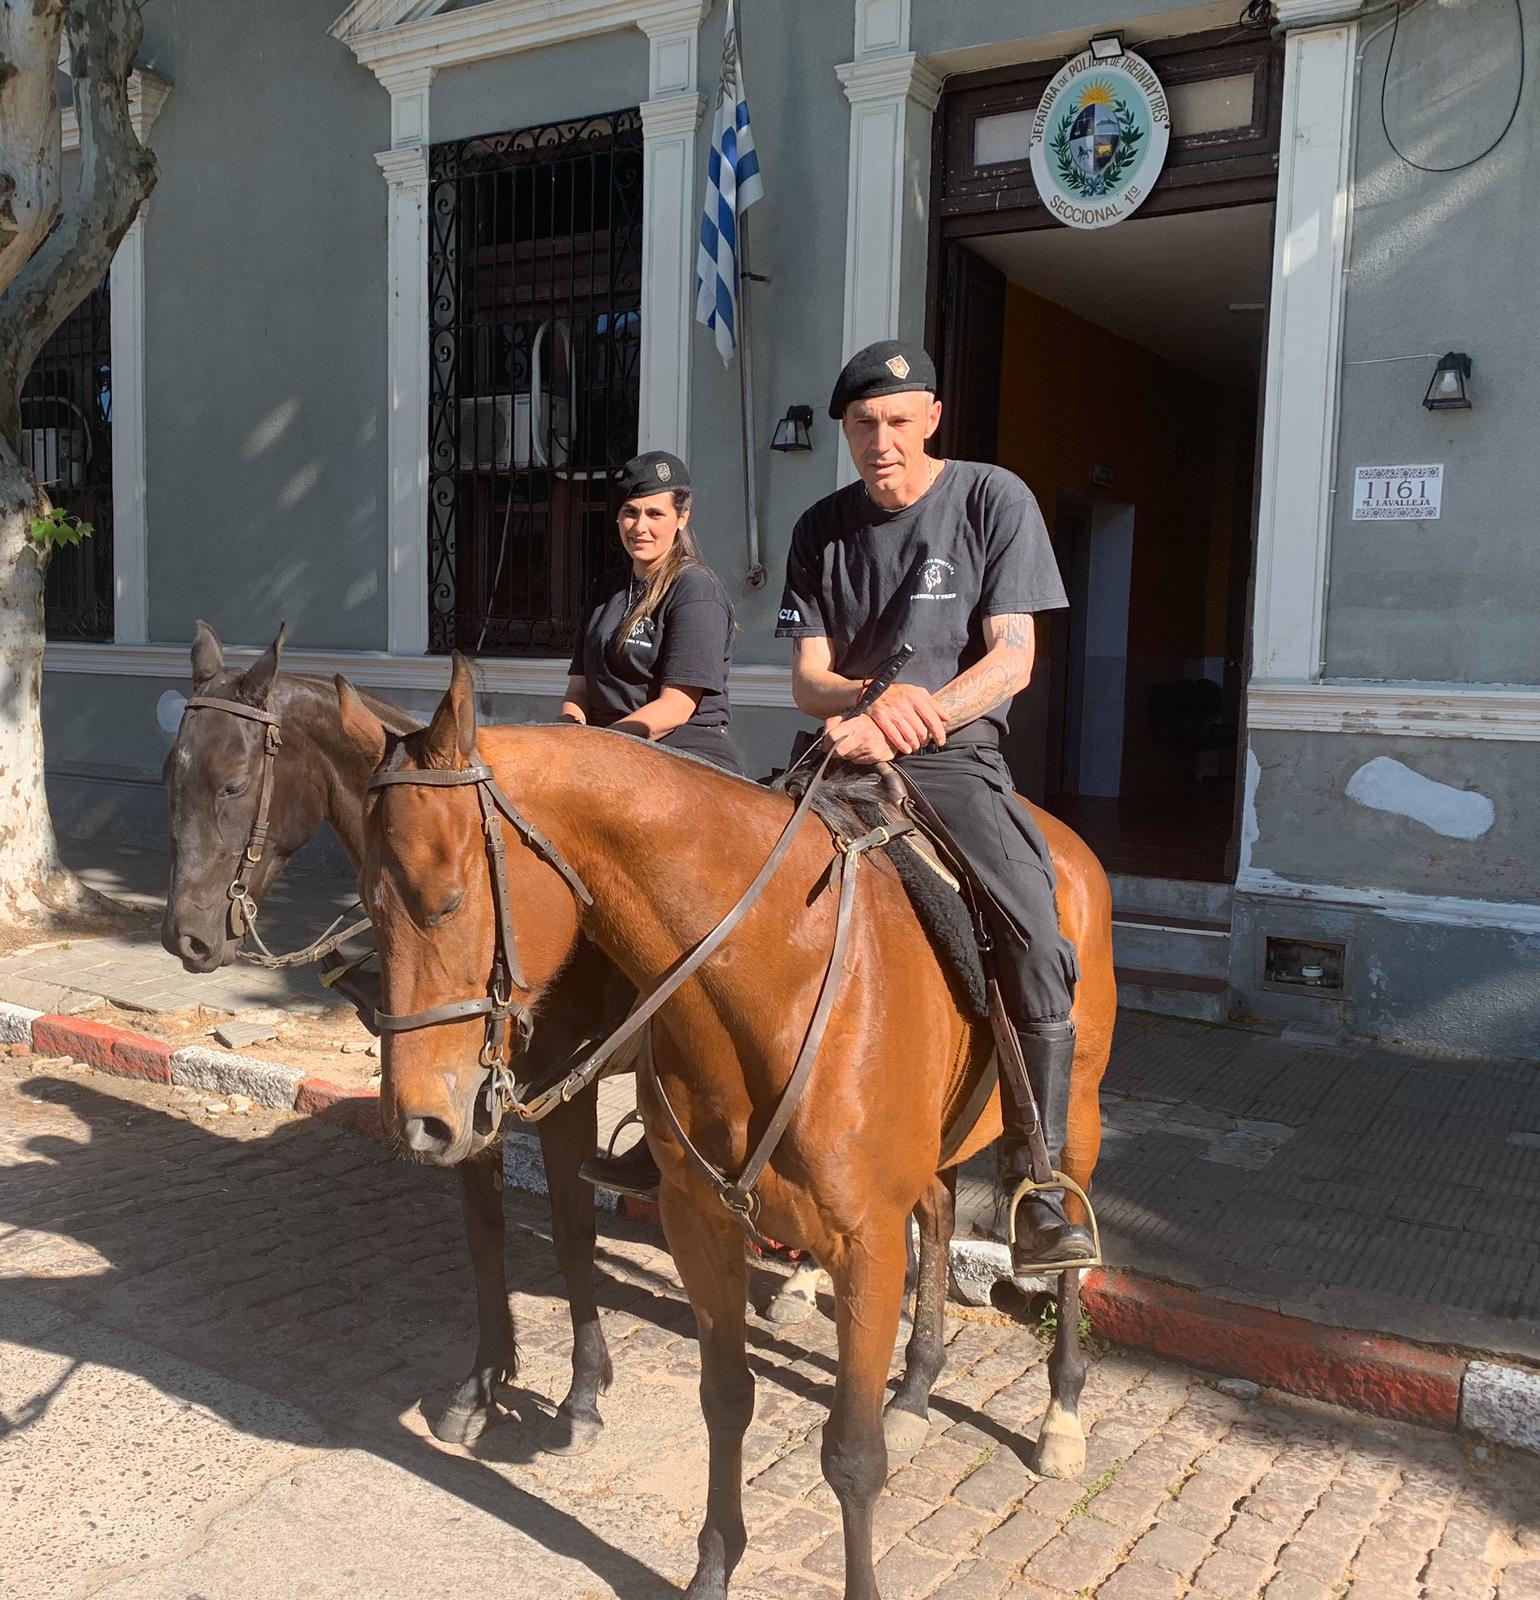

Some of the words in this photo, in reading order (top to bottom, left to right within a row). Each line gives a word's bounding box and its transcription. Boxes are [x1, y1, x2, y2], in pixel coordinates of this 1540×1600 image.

[1032, 86, 1060, 142] JEFATURA
[1058, 73, 1069, 88] DE
[1121, 56, 1159, 93] TREINTA
[1149, 95, 1169, 123] TRES
[1050, 195, 1123, 225] SECCIONAL
[1366, 479, 1427, 499] 1161
[1376, 498, 1431, 507] LAVALLEJA
